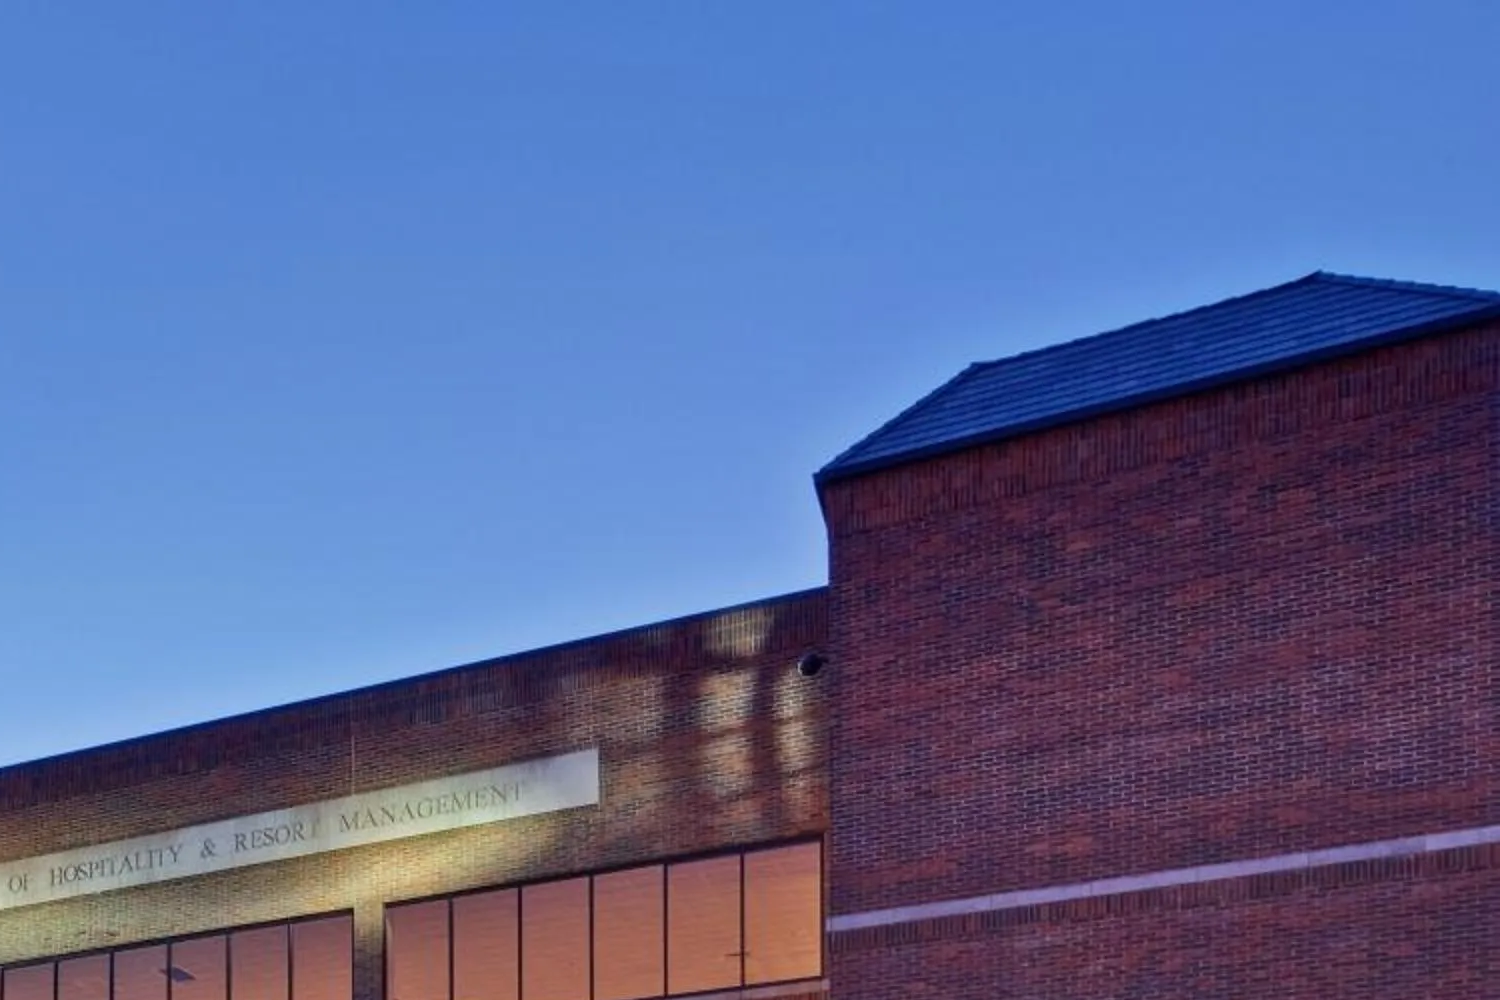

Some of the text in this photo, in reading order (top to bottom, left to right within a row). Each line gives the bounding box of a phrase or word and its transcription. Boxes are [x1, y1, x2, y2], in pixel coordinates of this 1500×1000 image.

[8, 873, 33, 894] OF
[50, 843, 183, 887] HOSPITALITY
[201, 837, 217, 859] &
[234, 816, 320, 853] RESORT
[339, 780, 526, 833] MANAGEMENT
